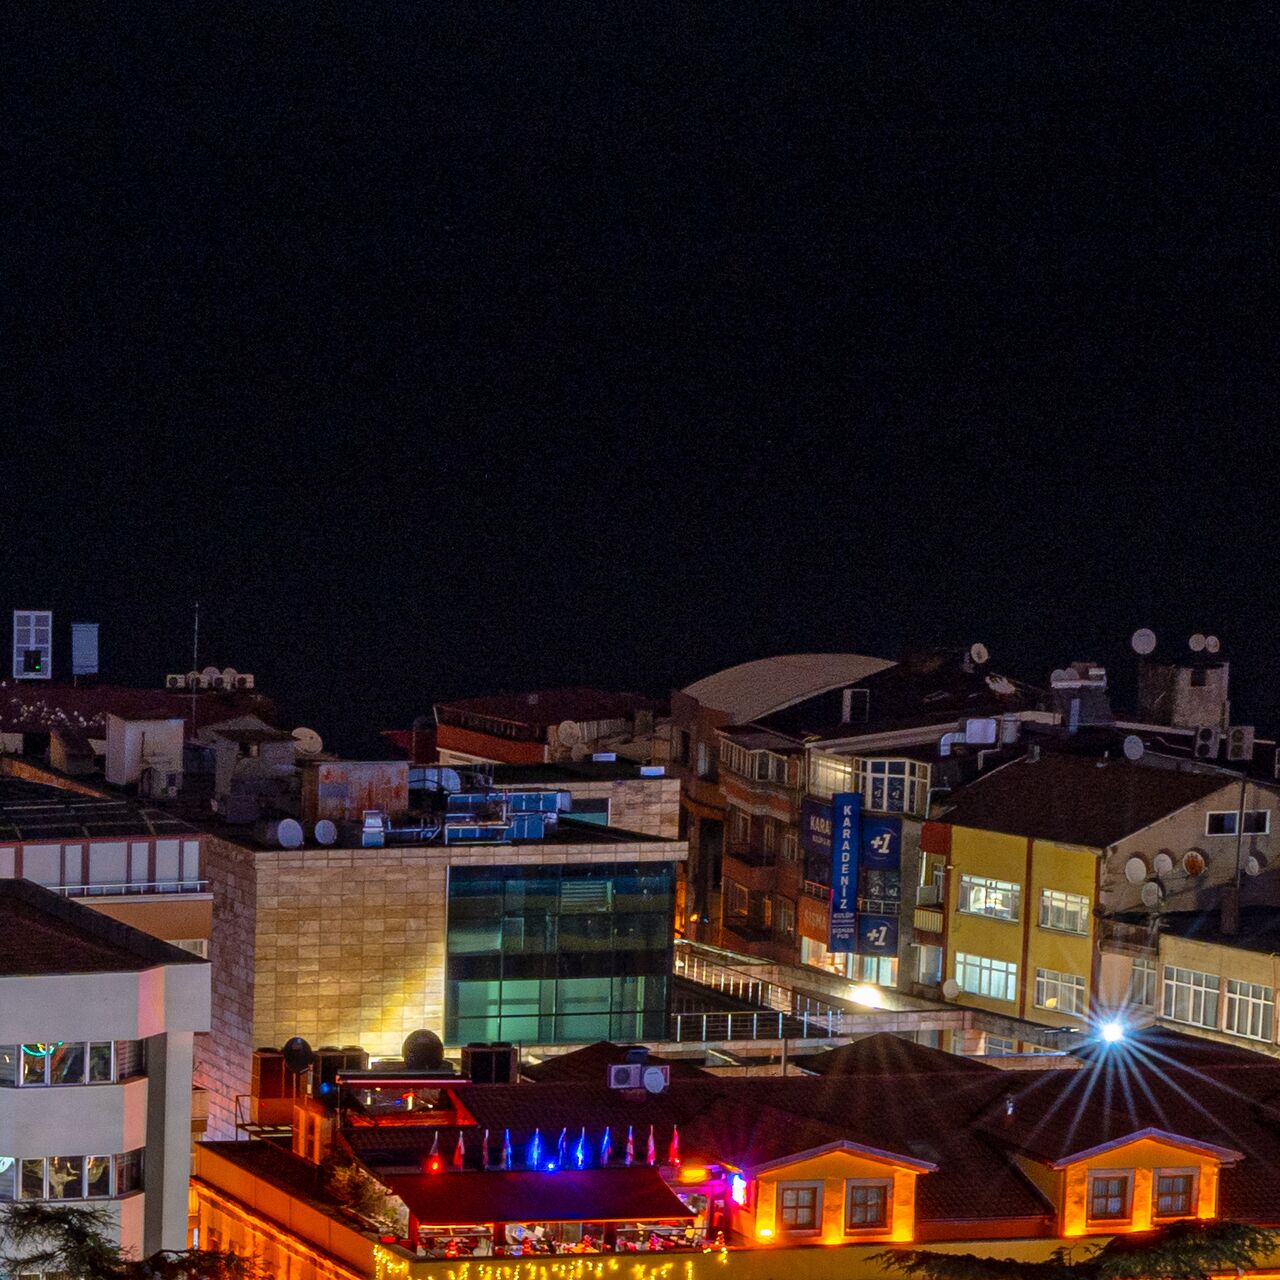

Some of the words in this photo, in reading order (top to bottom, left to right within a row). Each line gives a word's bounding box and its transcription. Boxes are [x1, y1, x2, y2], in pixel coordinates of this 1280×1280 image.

[870, 833, 891, 854] +1
[839, 804, 852, 909] KARADENİZ
[866, 926, 888, 946] +1
